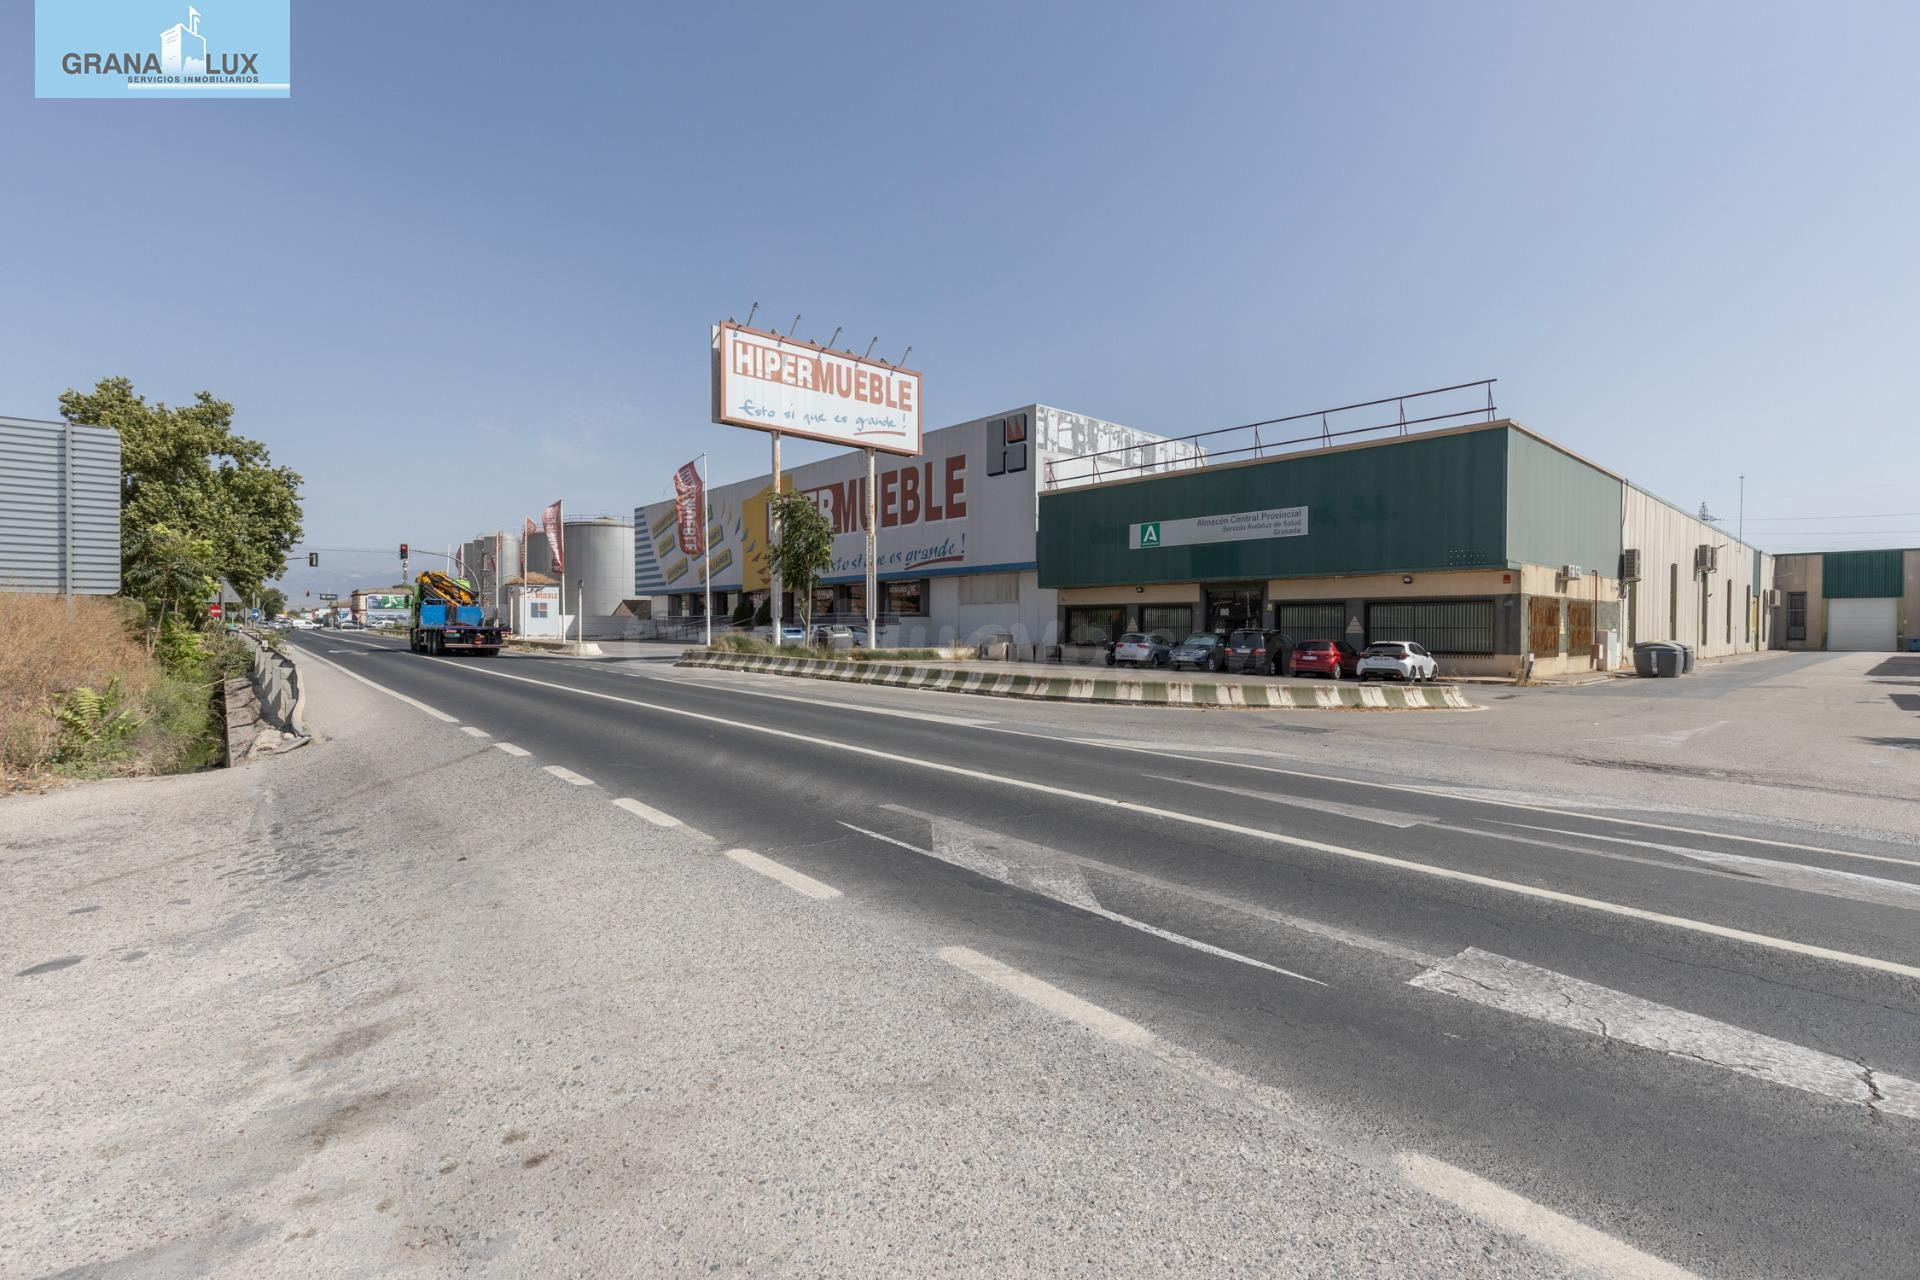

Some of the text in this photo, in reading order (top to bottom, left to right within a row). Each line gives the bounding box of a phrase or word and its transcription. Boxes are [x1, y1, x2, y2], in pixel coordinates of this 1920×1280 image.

[738, 398, 776, 418] Esto
[803, 412, 827, 426] que
[834, 414, 848, 424] es
[1197, 517, 1229, 527] Almacén
[1230, 513, 1259, 524] Central
[1261, 509, 1302, 521] Provincial
[1222, 525, 1246, 533] Servicio
[1247, 522, 1272, 530] Andaluz
[1283, 518, 1301, 527] Salud
[1273, 527, 1301, 535] Granada
